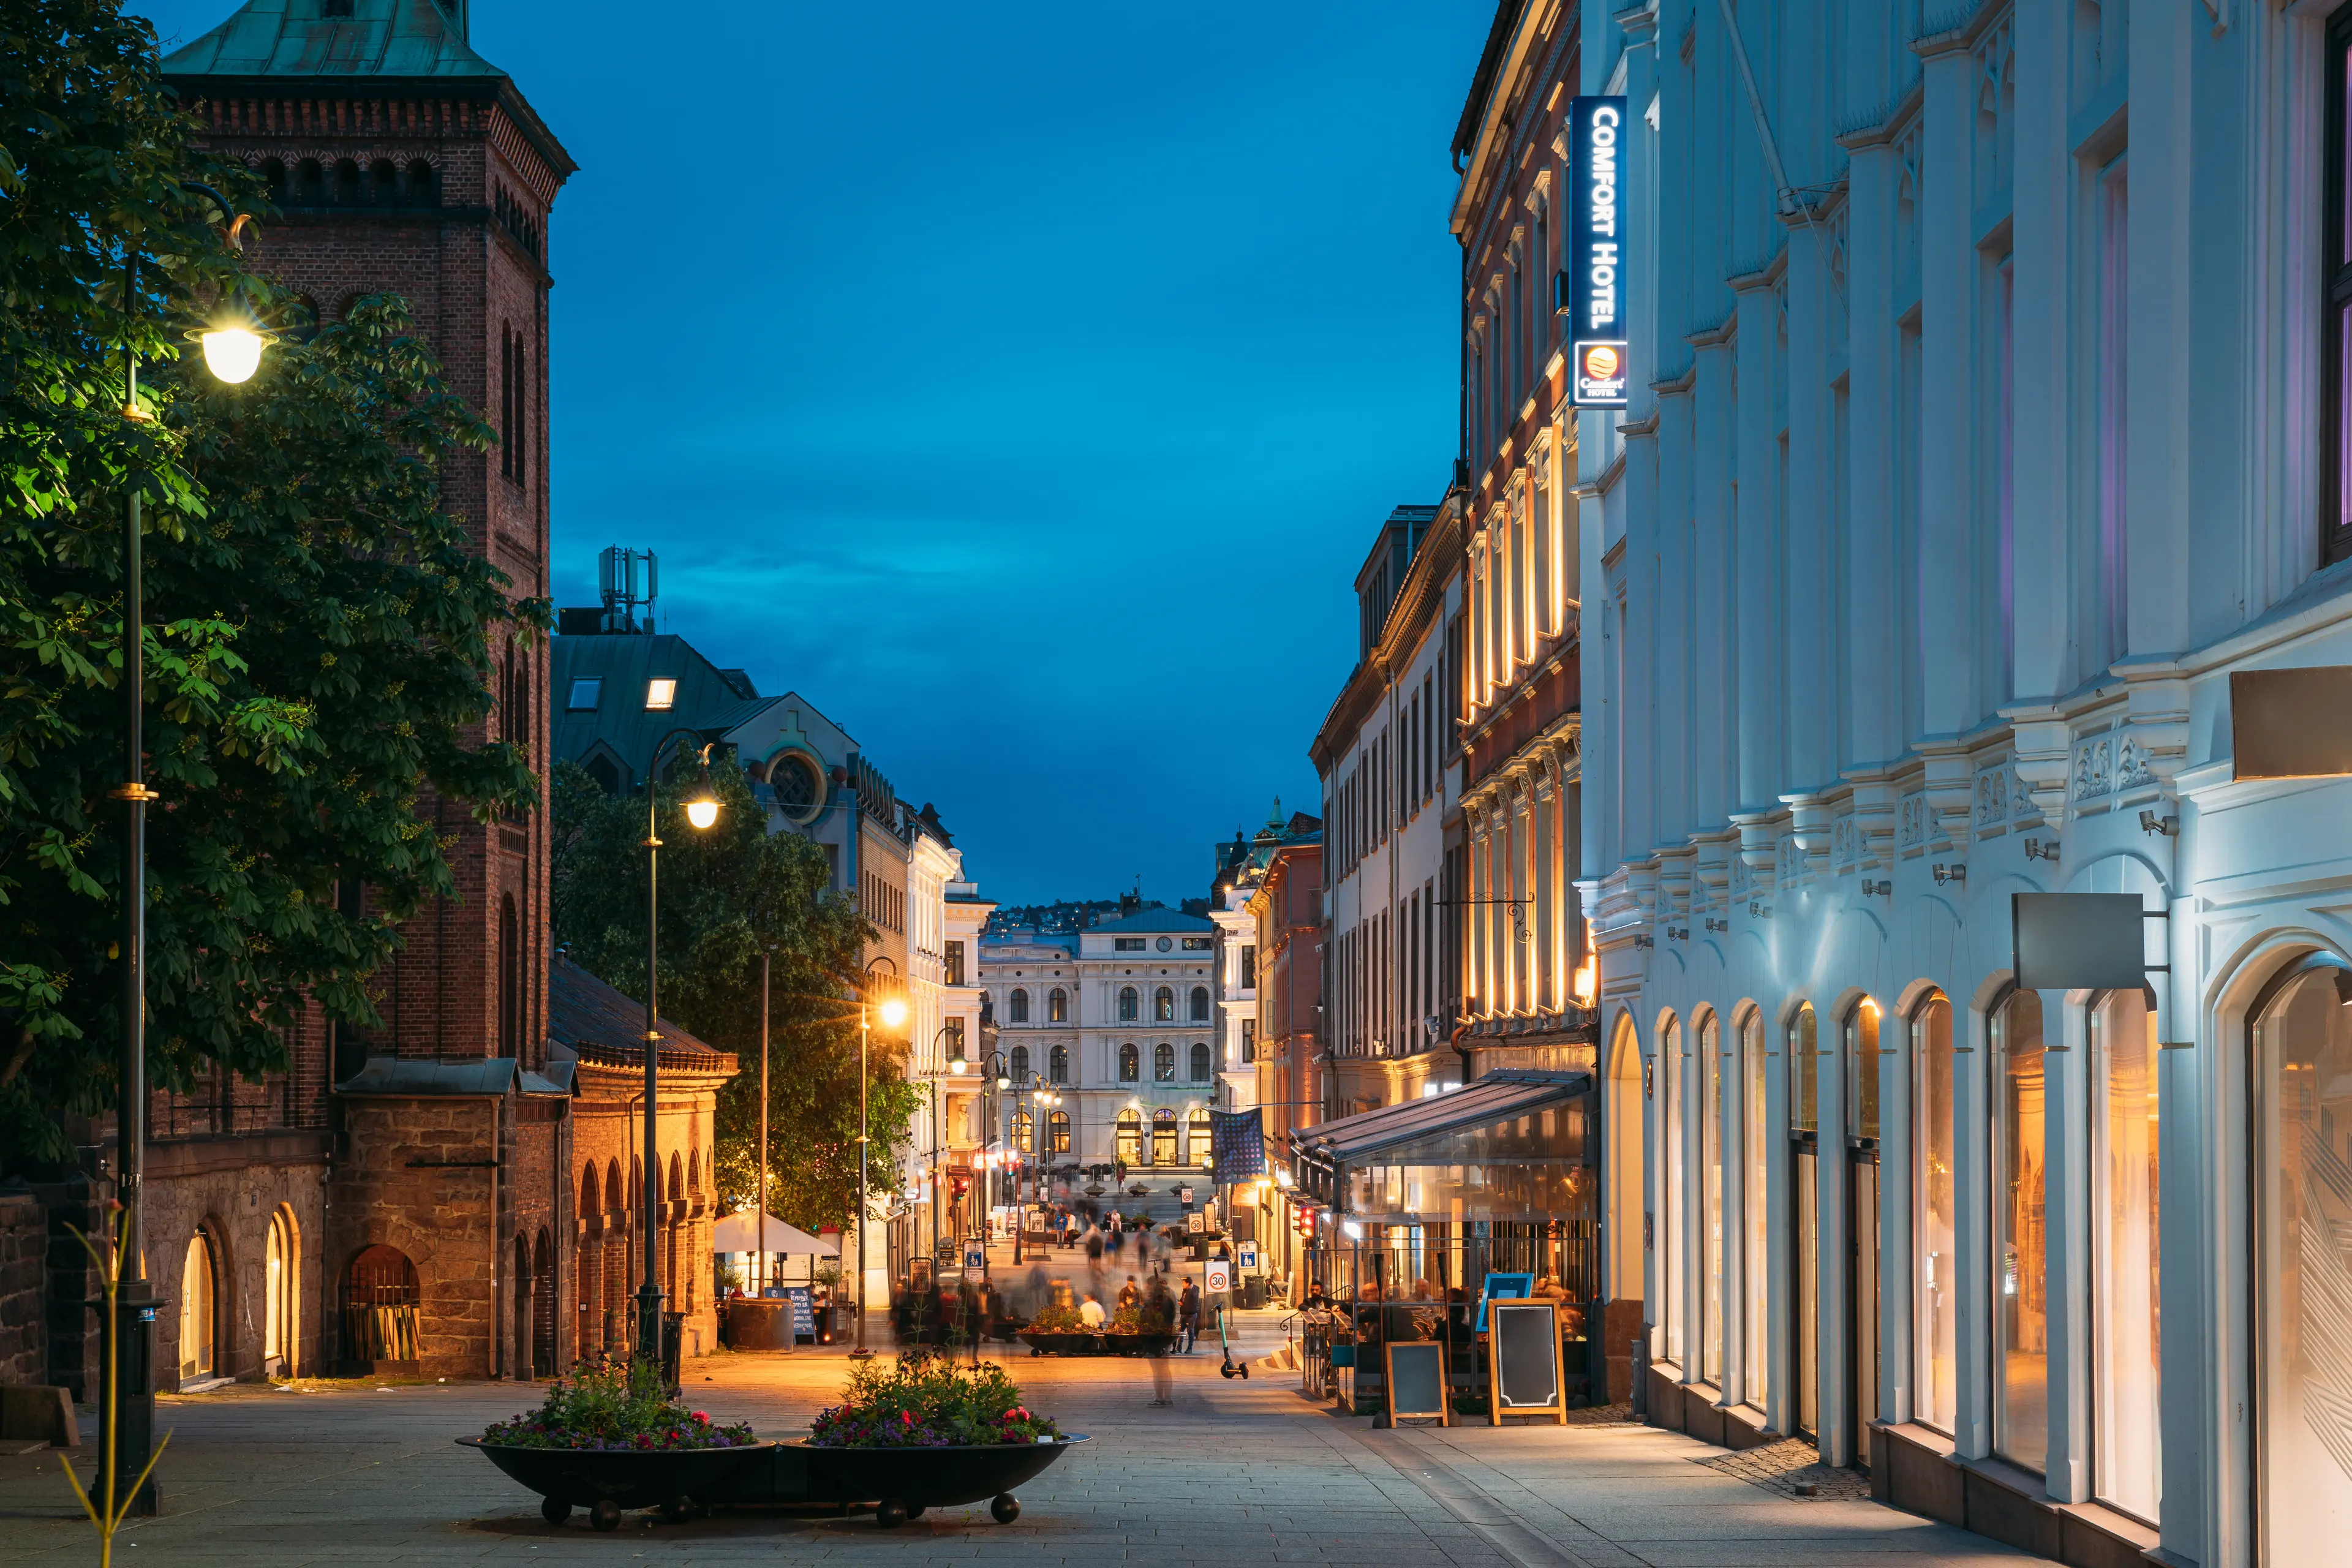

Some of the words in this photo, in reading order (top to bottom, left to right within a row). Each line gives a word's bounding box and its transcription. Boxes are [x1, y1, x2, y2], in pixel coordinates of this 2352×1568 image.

[1592, 107, 1619, 237] COMFORT
[1591, 243, 1618, 330] HOTEL
[1587, 388, 1617, 397] HOTEL
[1212, 1277, 1224, 1286] 30
